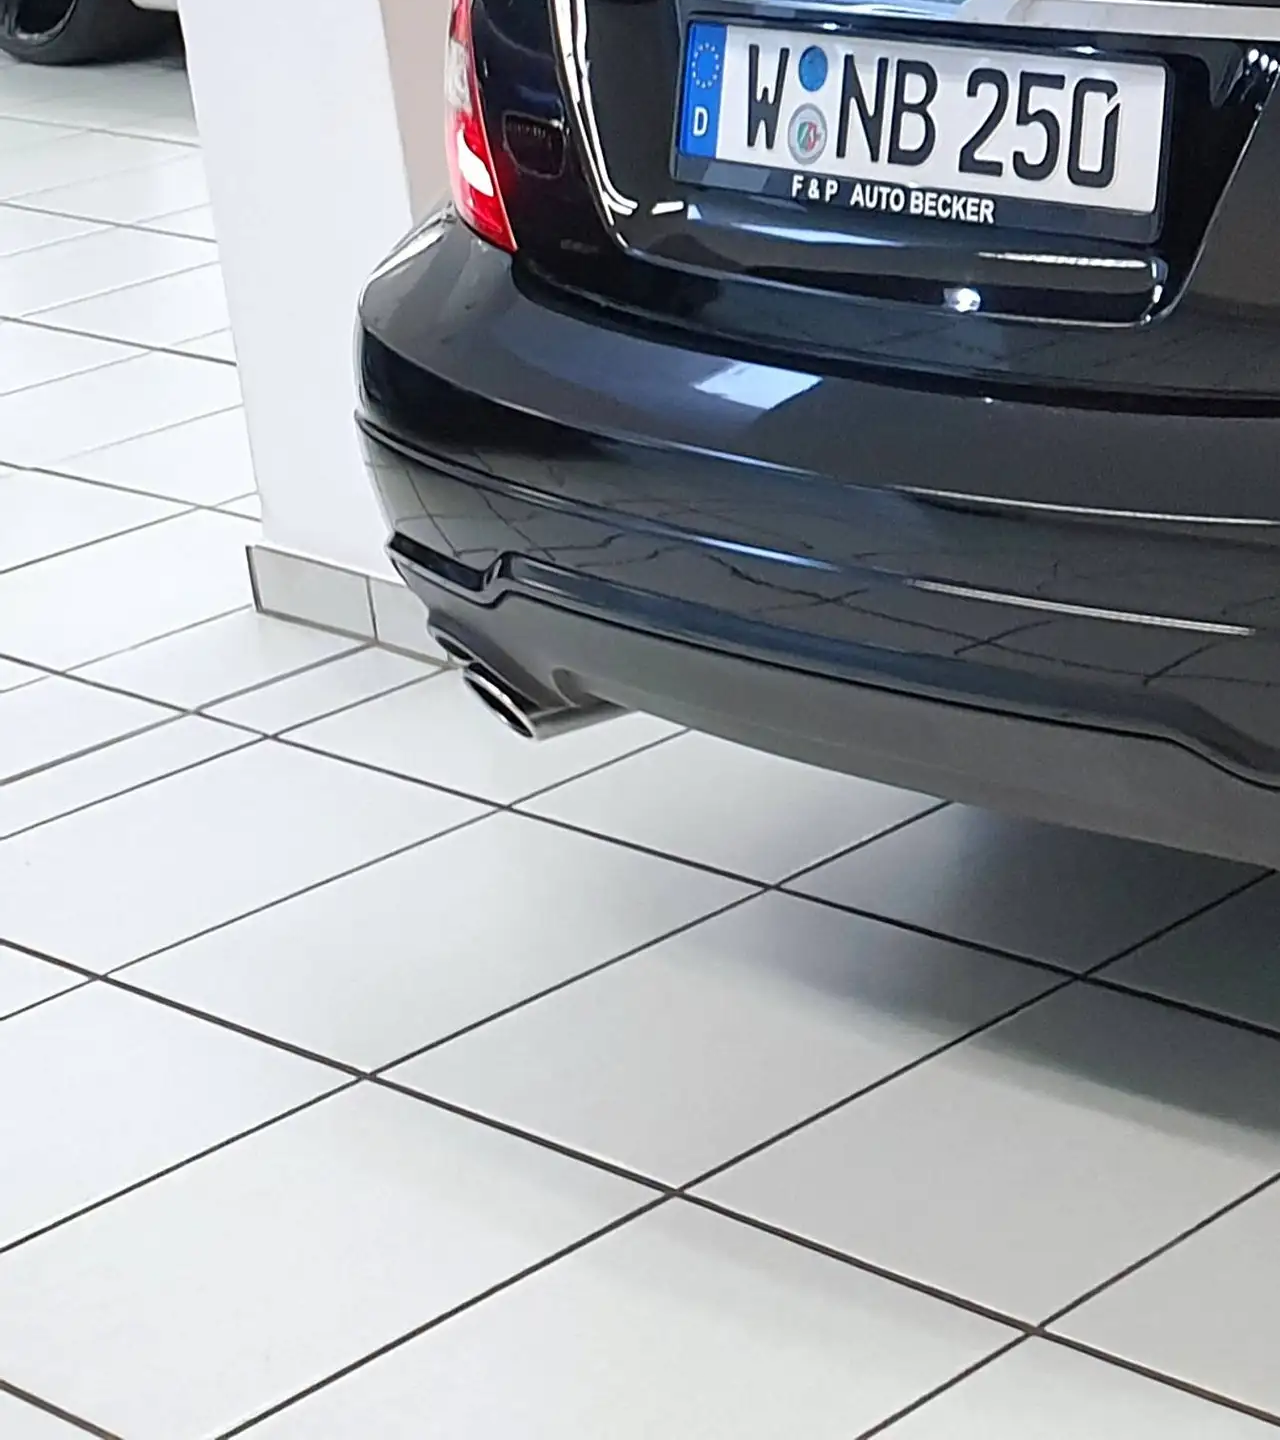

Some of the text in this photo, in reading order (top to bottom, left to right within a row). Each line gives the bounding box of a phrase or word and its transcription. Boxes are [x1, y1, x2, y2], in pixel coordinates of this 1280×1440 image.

[692, 105, 708, 139] D
[745, 44, 1123, 191] W NB 250
[791, 174, 996, 225] F & P AUTO BECKER
